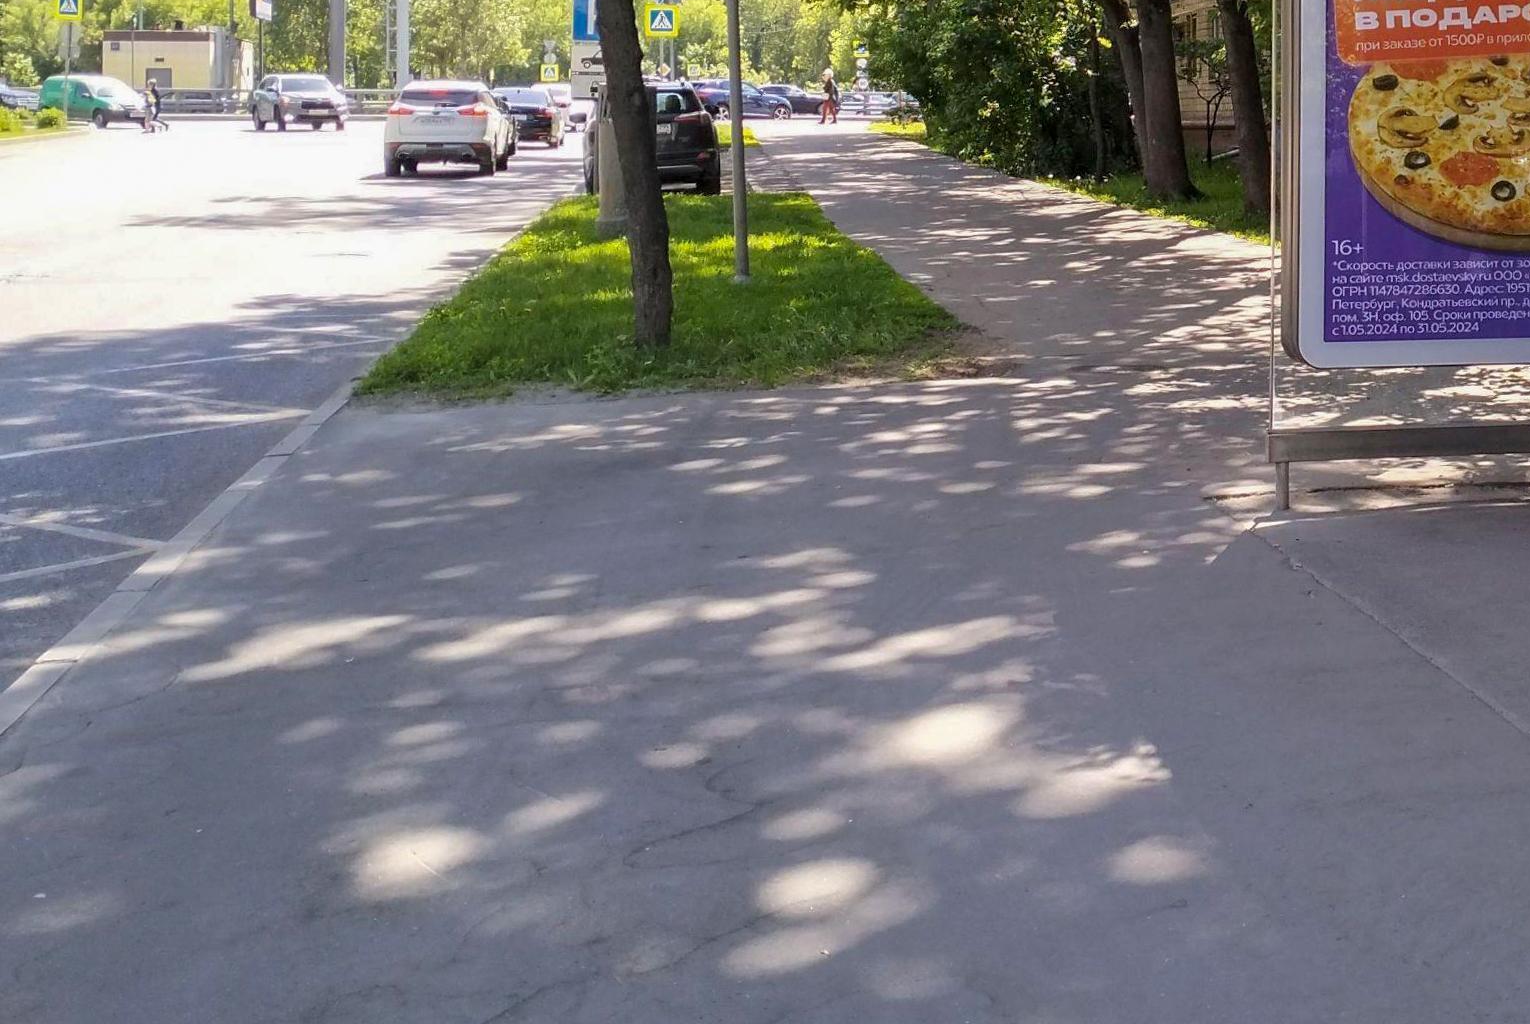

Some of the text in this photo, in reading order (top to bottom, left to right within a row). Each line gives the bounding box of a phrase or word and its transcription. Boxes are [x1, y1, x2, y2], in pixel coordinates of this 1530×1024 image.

[1354, 11, 1379, 30] В
[1356, 40, 1380, 52] при
[1383, 39, 1426, 50] заказе
[1428, 37, 1443, 48] от
[1446, 34, 1485, 47] 1500₽
[1487, 35, 1494, 45] в
[1331, 240, 1365, 256] 16+
[1396, 260, 1451, 272] доставки
[1452, 260, 1499, 271] зависит
[1501, 260, 1514, 268] от
[1332, 276, 1347, 284] на
[1349, 273, 1384, 284] сайте
[1386, 271, 1491, 285] msk.dostaevsky.ru
[1494, 270, 1522, 281] ООО
[1332, 286, 1367, 297] ОГРН
[1332, 299, 1400, 312] Петербург,
[1401, 296, 1498, 309] Кондратьевский
[1332, 314, 1360, 323] пом.
[1383, 311, 1407, 324] оф.
[1434, 310, 1471, 322] Сроки
[1332, 322, 1479, 336] с 1.05.2024 по 31.05.2024
